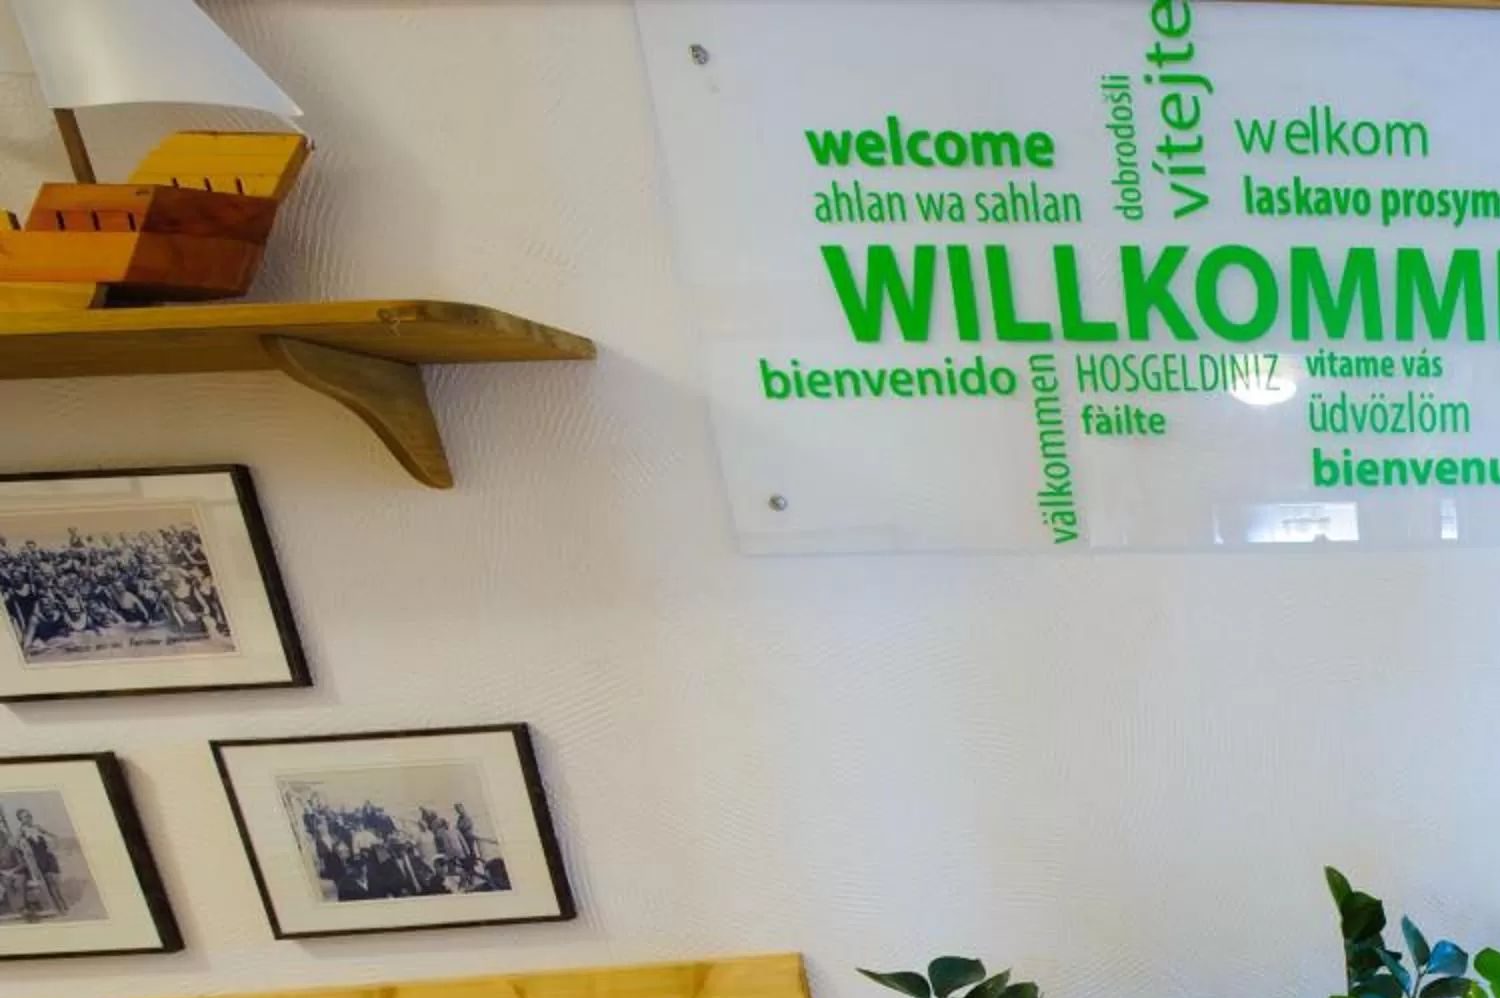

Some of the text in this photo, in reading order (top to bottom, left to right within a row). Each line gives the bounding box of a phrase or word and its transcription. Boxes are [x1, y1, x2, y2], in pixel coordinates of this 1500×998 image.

[1142, 0, 1215, 219] vítejte
[1234, 105, 1430, 158] welkom
[804, 116, 1056, 168] welcome
[1100, 74, 1145, 222] dobrodošli
[813, 180, 1082, 223] ahlan wa sahlan
[1243, 175, 1372, 217] laskavo
[759, 355, 1018, 401] bienvenido
[1305, 347, 1443, 378] vitame vás
[1080, 403, 1167, 436] fàilte
[1307, 391, 1471, 434] üdvözlöm
[1028, 353, 1079, 545] välkommen
